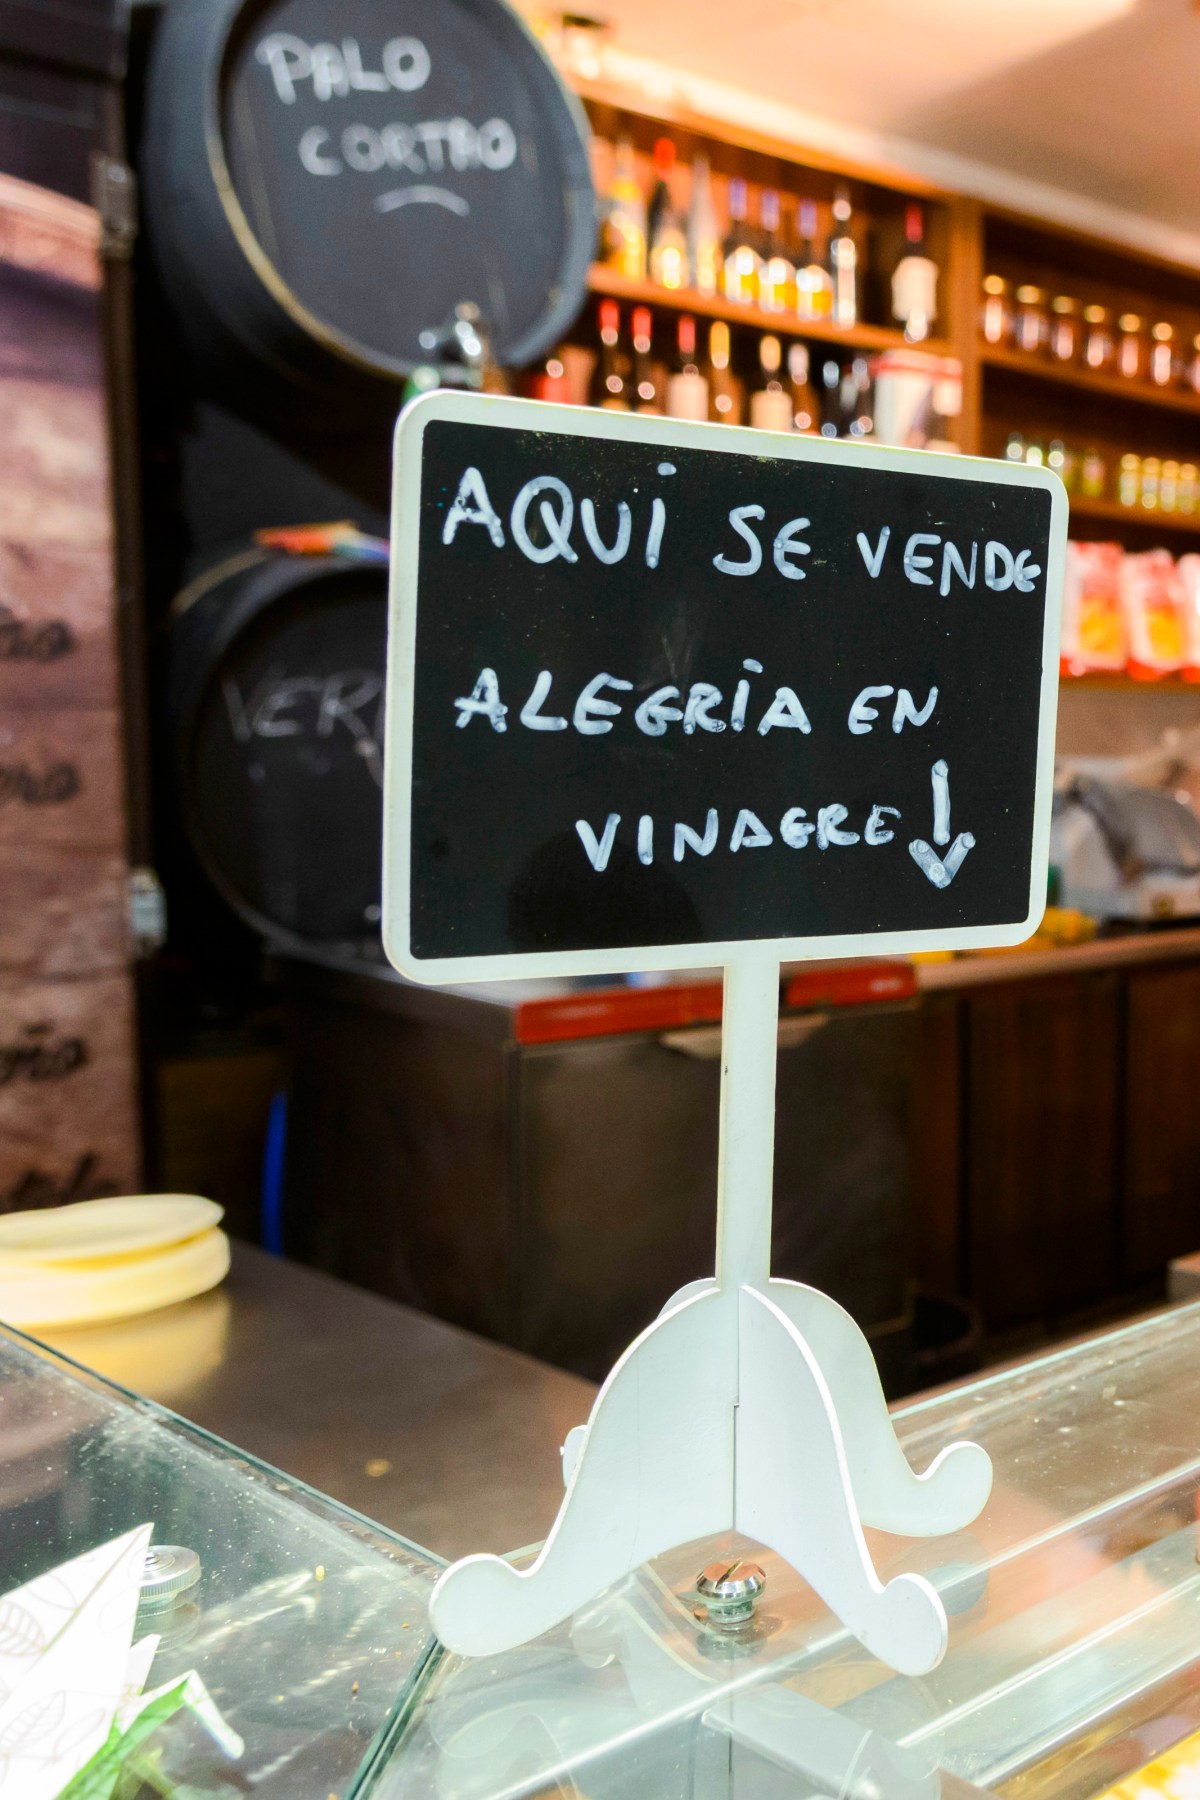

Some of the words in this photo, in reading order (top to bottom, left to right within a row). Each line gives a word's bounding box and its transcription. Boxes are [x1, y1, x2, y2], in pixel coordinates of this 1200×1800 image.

[254, 31, 432, 105] PALO
[712, 504, 811, 580] SE
[856, 525, 1042, 597] VENDE
[222, 666, 388, 743] VER
[847, 684, 939, 735] EN
[575, 803, 901, 872] VINAGRE
